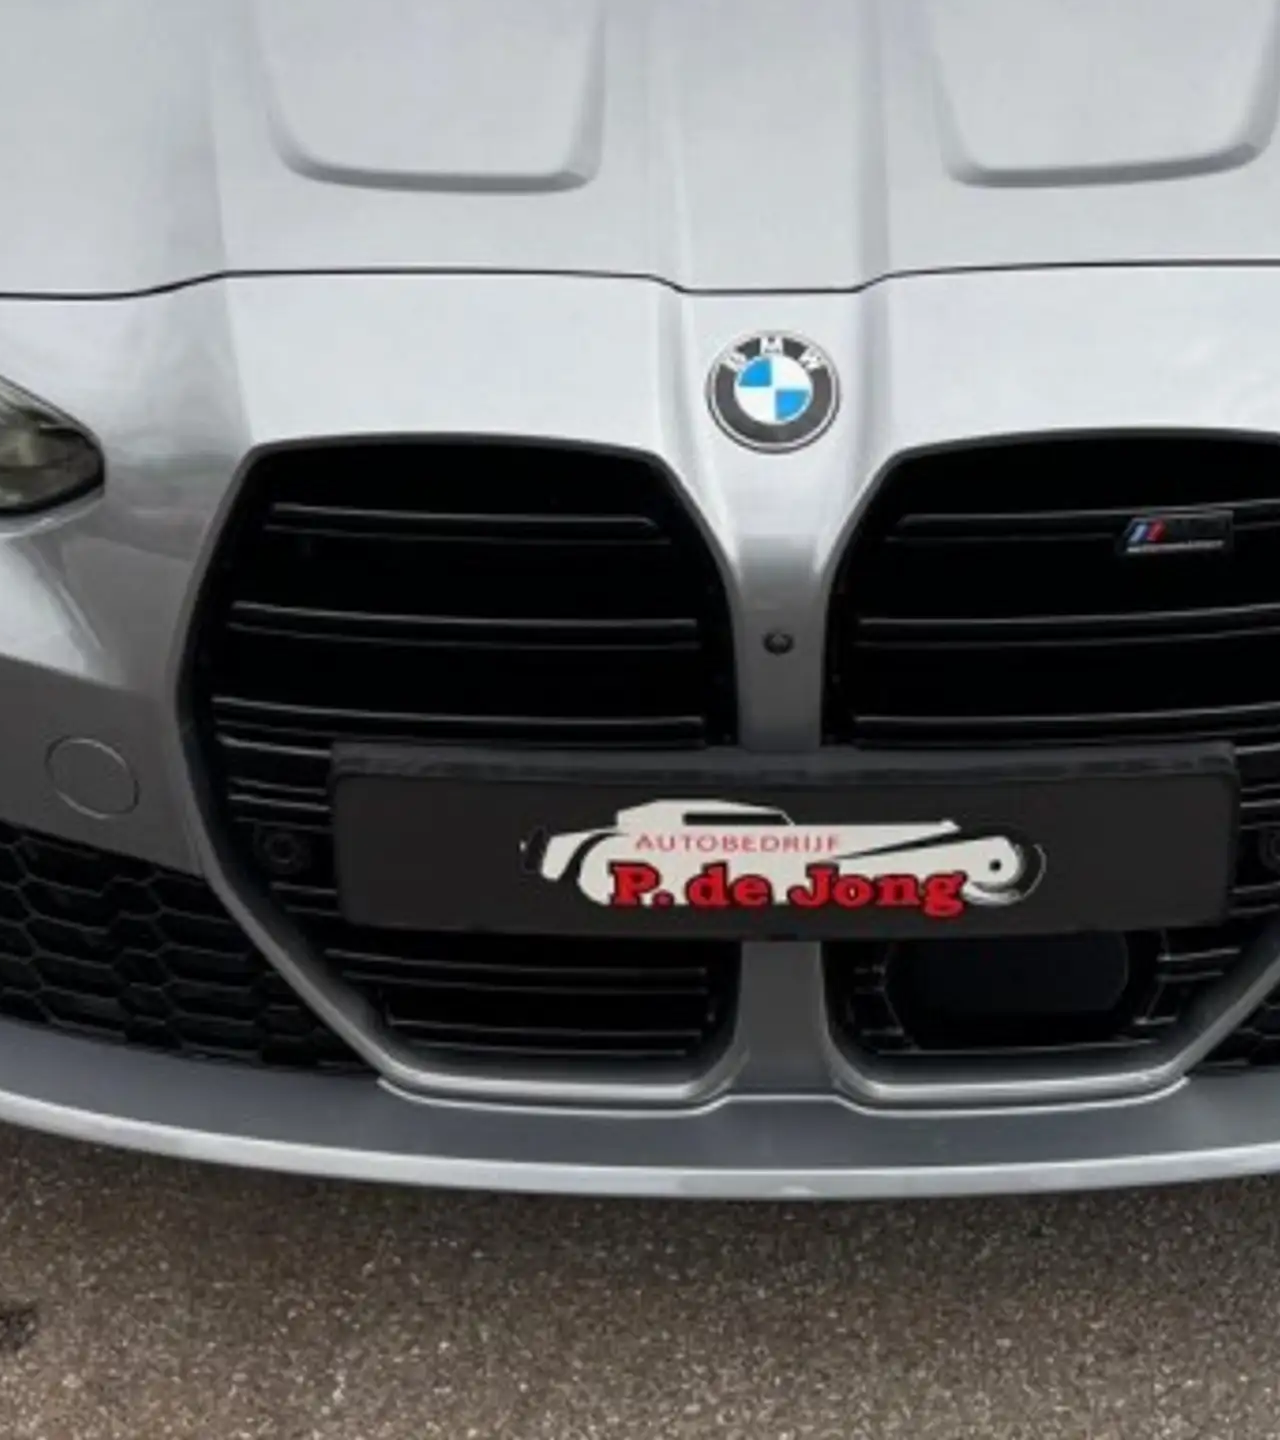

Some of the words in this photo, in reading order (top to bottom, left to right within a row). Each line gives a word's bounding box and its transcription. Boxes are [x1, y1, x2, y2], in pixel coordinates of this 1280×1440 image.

[635, 833, 842, 853] AUTOBEDRIJF
[608, 860, 675, 907] P.
[684, 860, 773, 907] de
[786, 862, 968, 919] Jong
